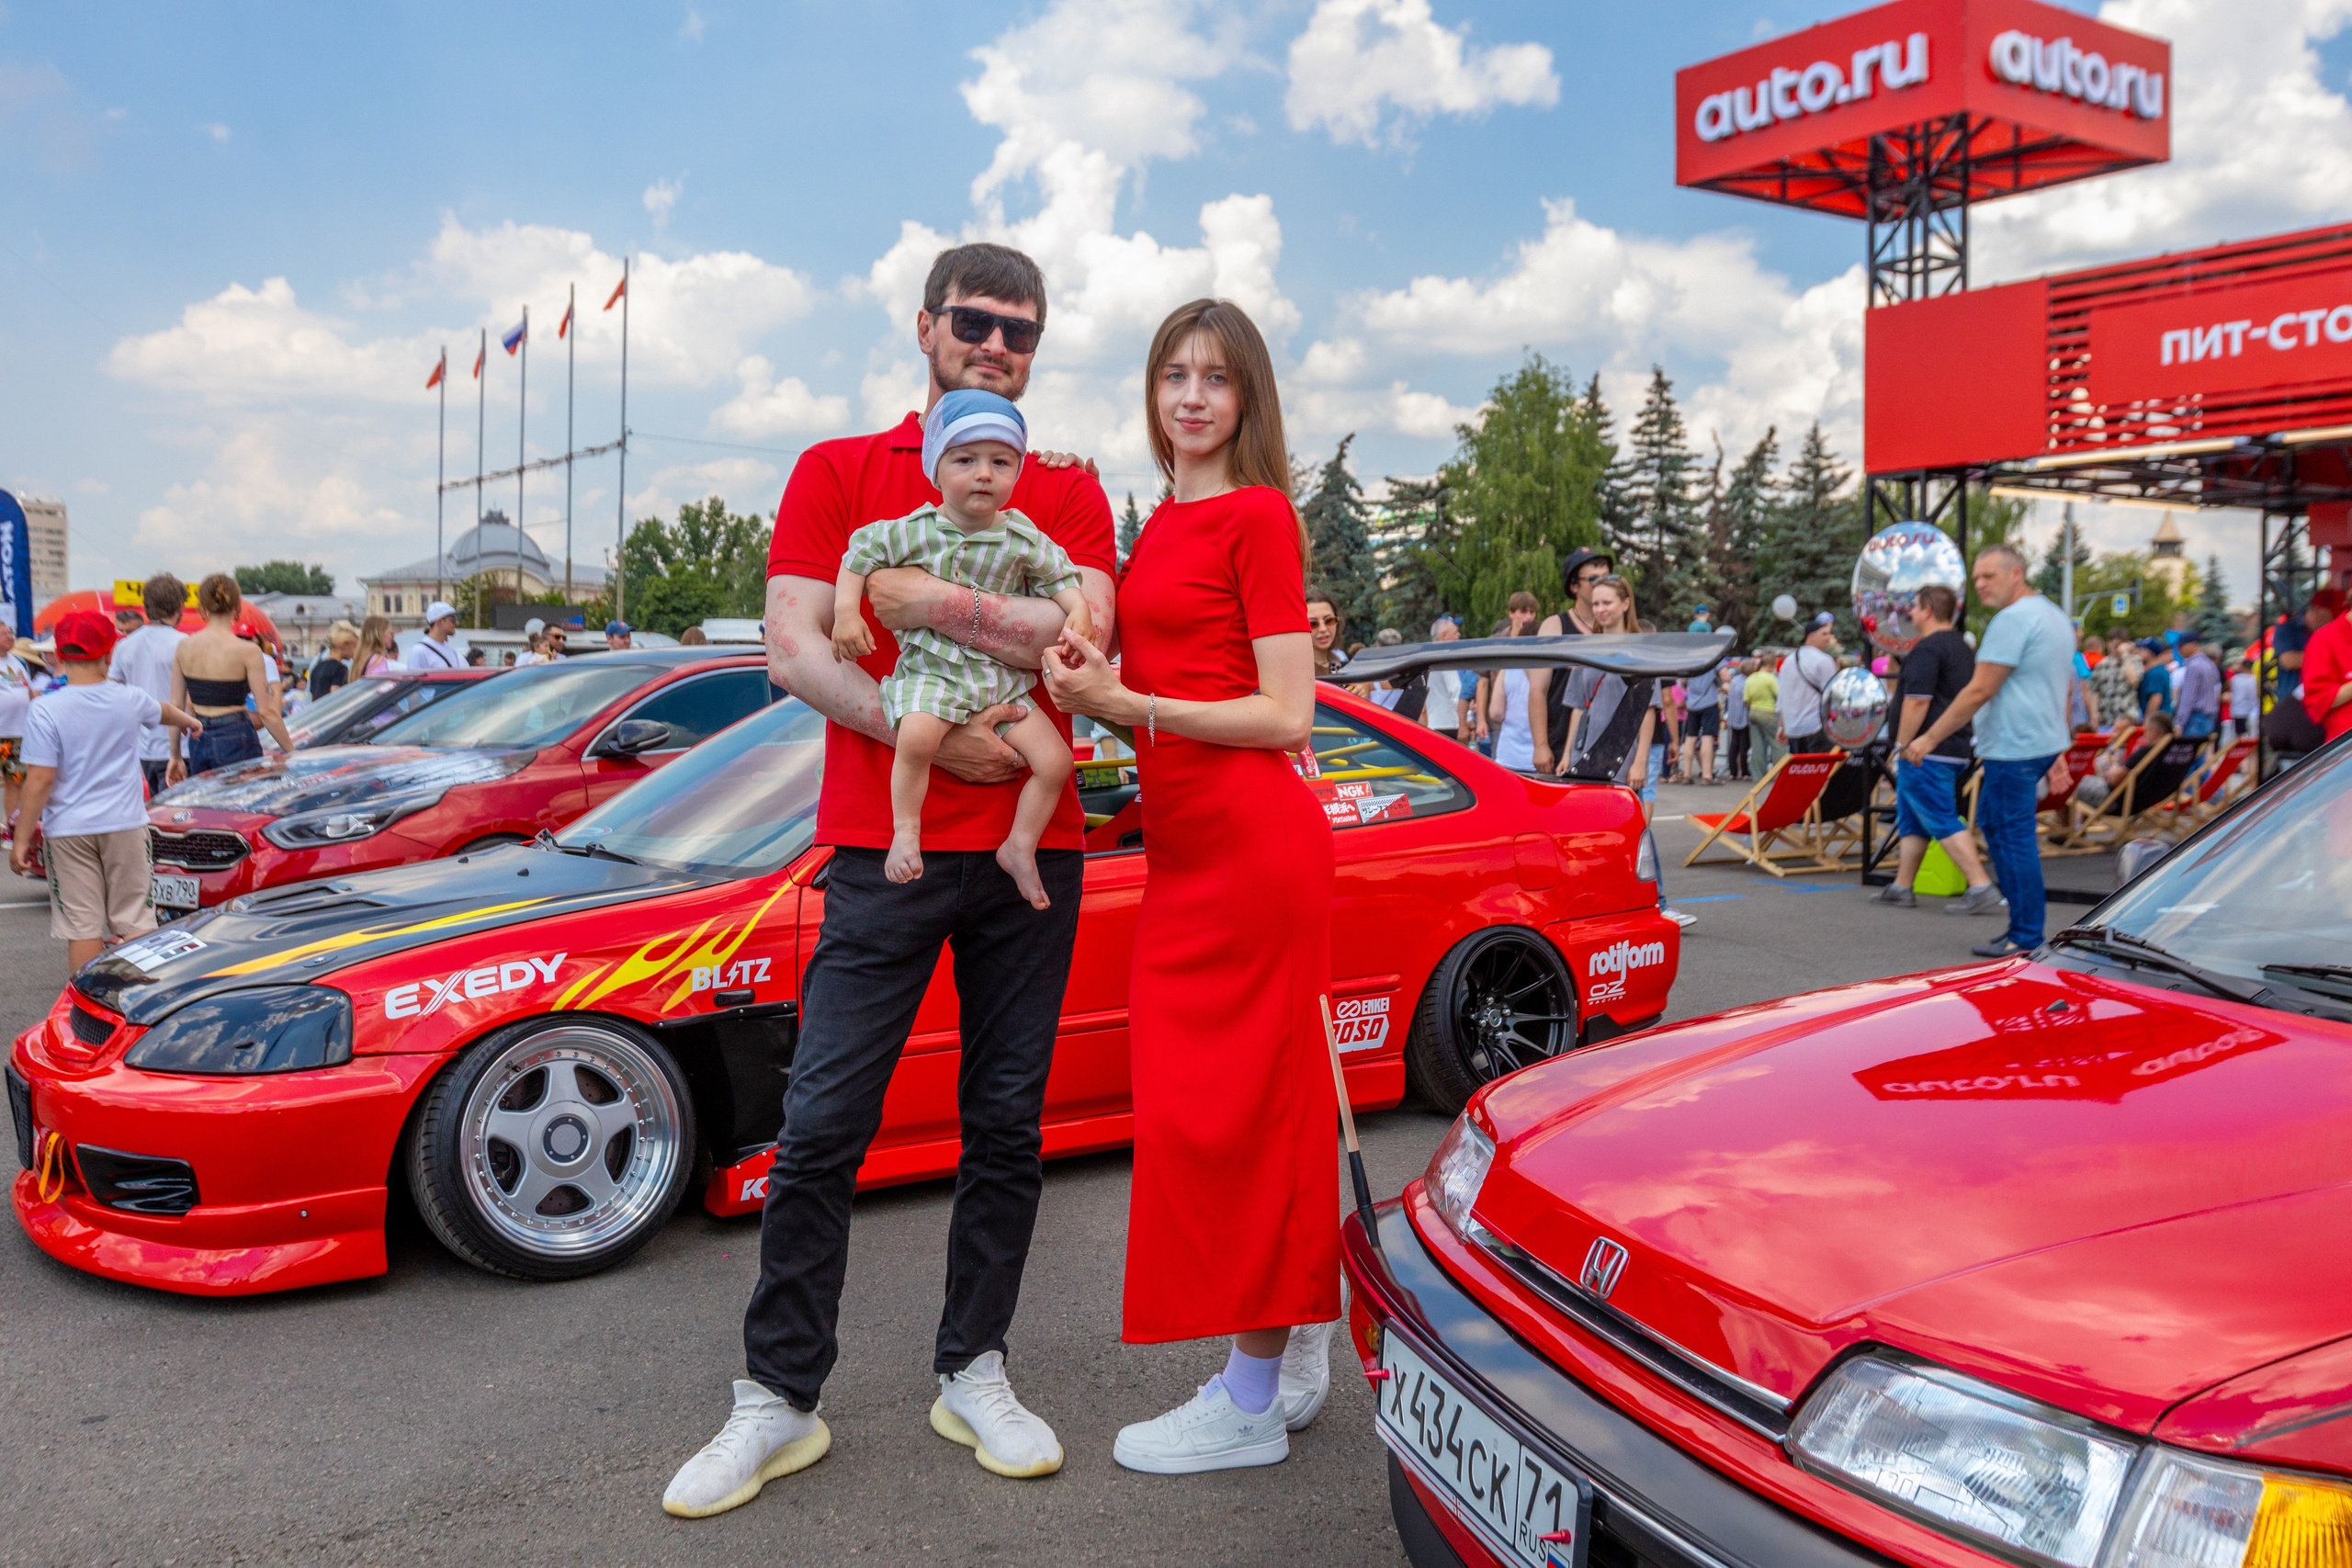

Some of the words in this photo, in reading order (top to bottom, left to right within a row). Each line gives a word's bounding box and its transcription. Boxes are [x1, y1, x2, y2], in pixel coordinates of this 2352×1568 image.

[1695, 33, 1929, 141] auto.ru
[1990, 30, 2163, 119] auto.ru
[1337, 784, 1365, 798] NGK
[175, 879, 196, 898] 790
[692, 957, 771, 993] BLITZ
[1589, 939, 1665, 981] rotiform
[385, 953, 568, 1020] EXEDY
[1361, 996, 1390, 1016] ENKEI
[1390, 1361, 1510, 1527] Х434СК
[1524, 1456, 1563, 1547] 71
[1520, 1521, 1546, 1562] RUS
